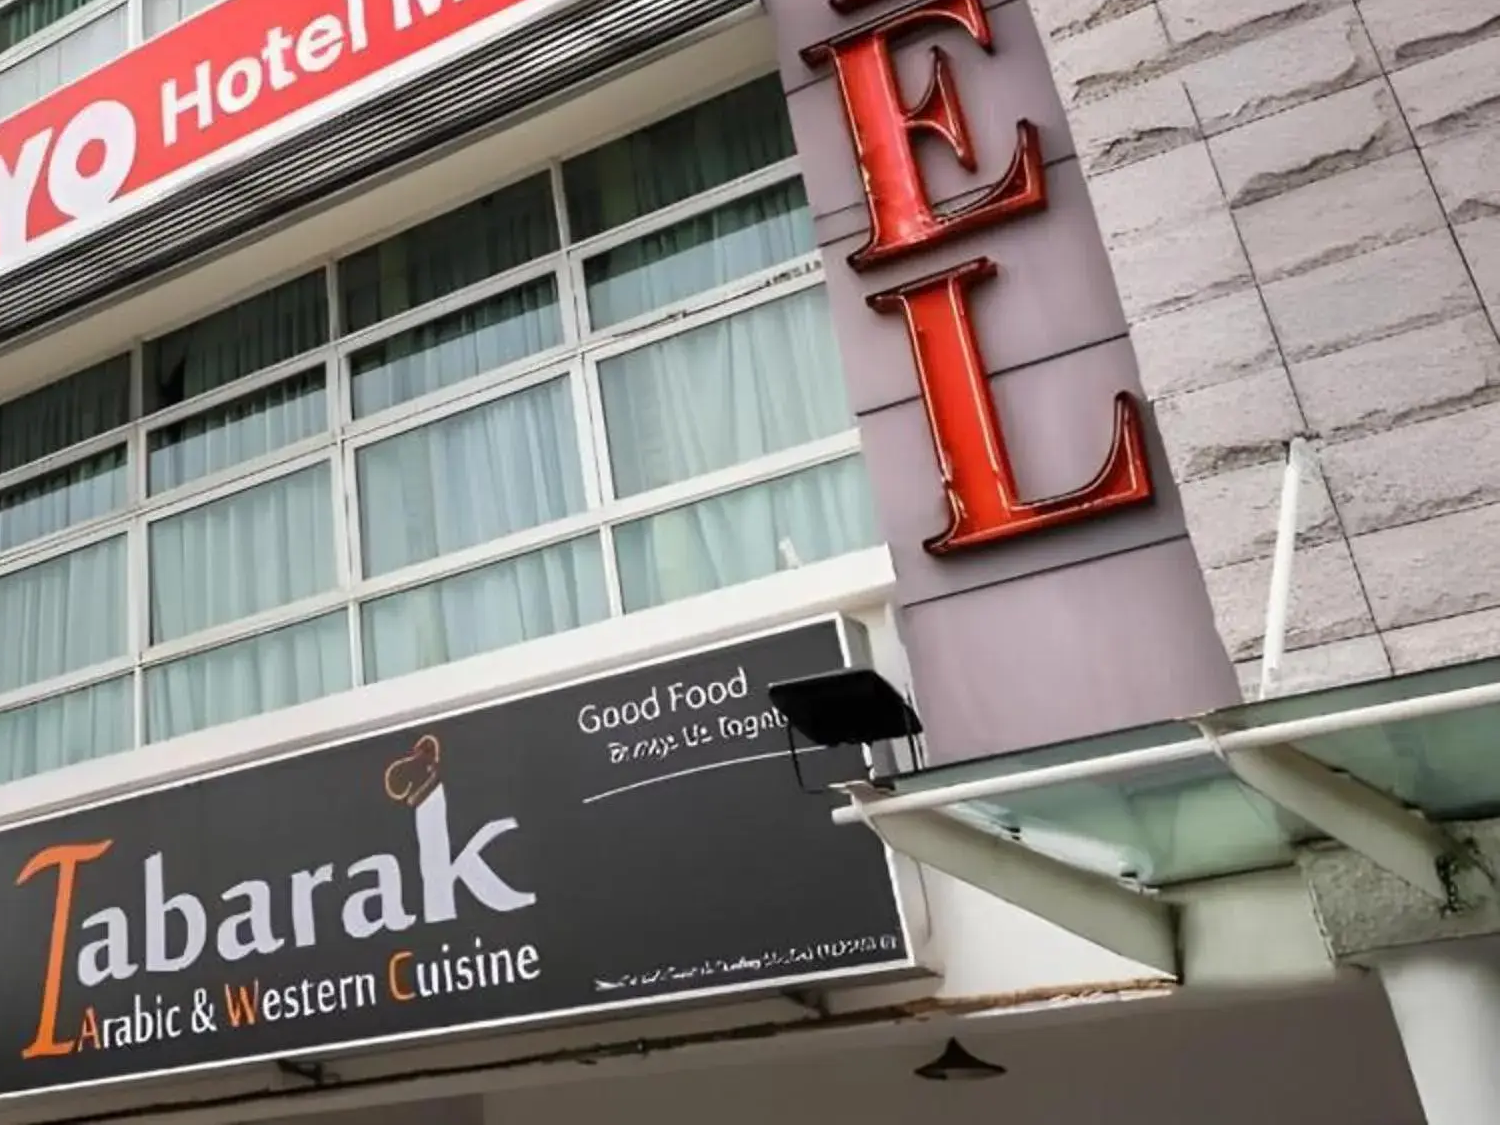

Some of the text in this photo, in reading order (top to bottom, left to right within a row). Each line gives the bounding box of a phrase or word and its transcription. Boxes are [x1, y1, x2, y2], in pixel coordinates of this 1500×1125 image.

[578, 666, 749, 733] Good Food
[16, 782, 537, 1059] Tabarak
[77, 996, 181, 1052] Arabic
[190, 988, 217, 1032] &
[224, 972, 376, 1027] Western
[388, 938, 542, 1002] Cuisine
